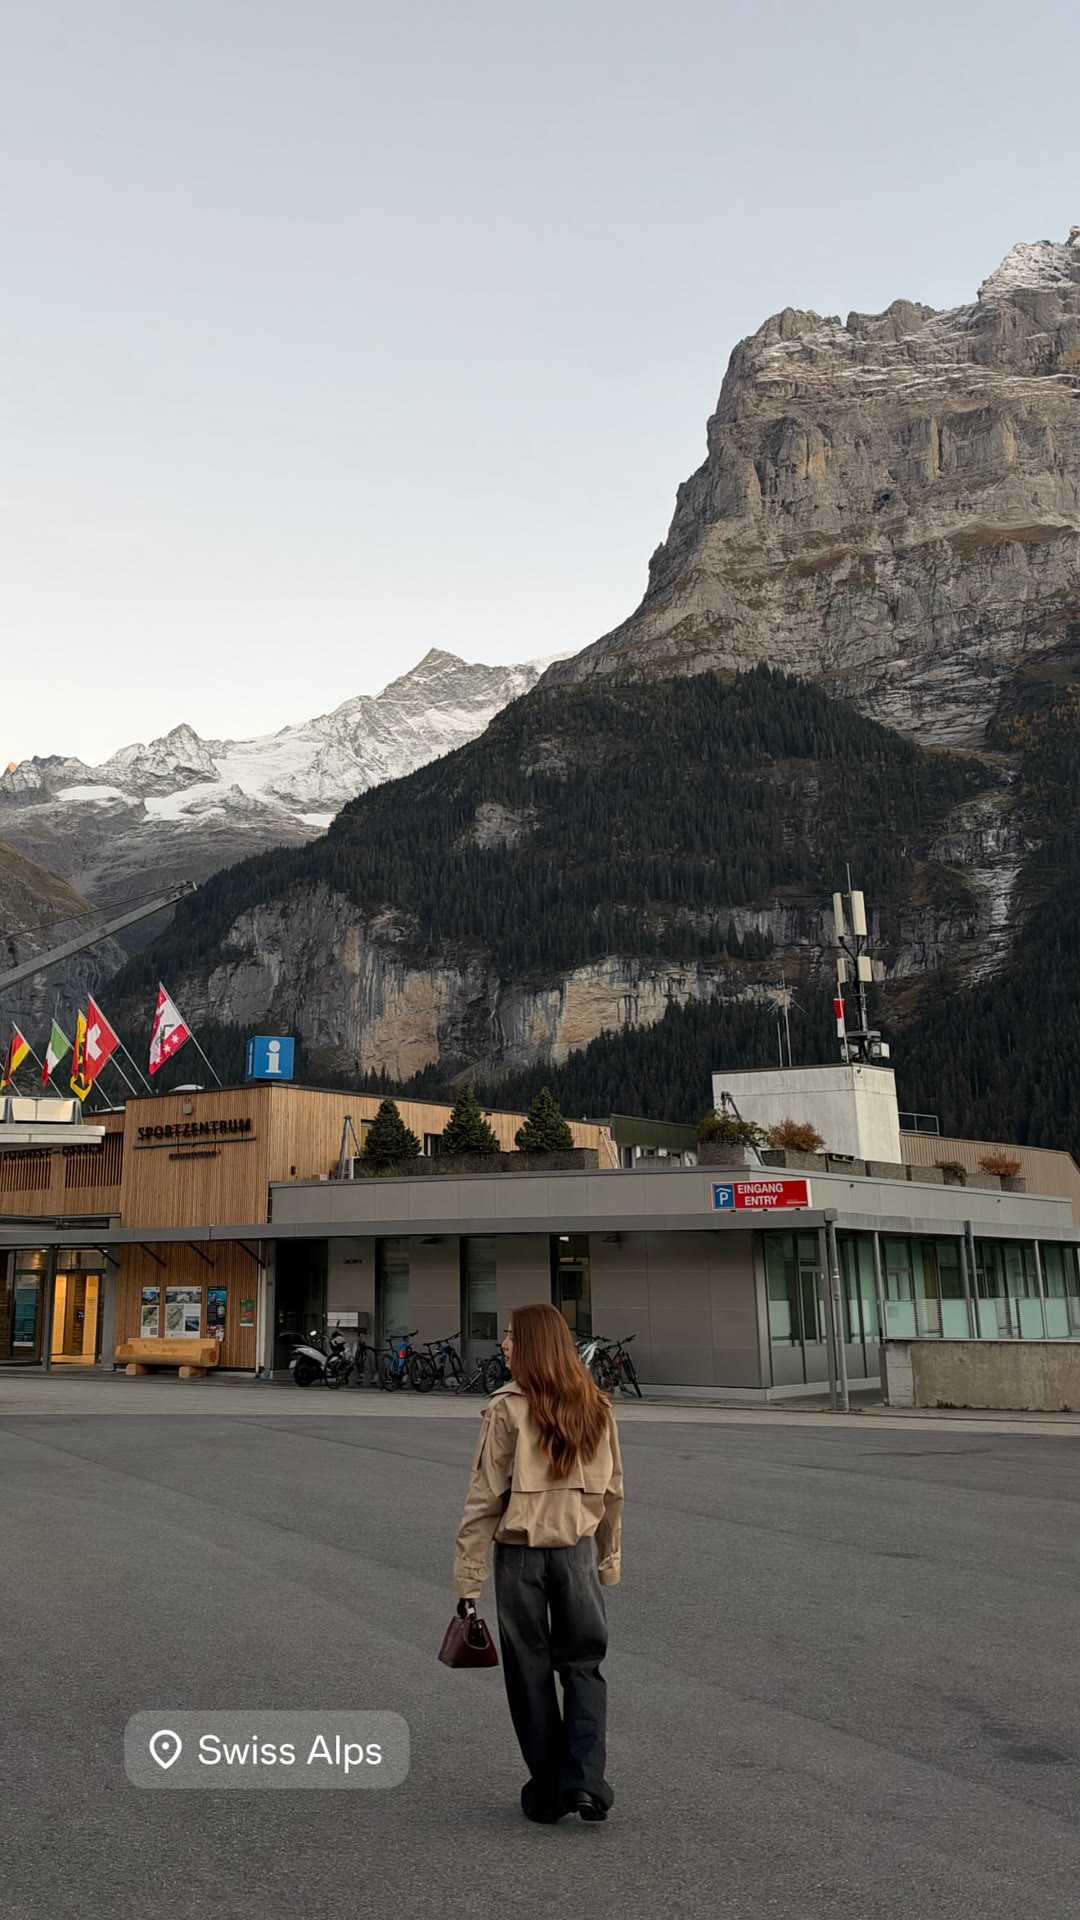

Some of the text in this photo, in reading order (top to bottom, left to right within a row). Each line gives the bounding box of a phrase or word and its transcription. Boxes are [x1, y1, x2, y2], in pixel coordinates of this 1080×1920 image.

[137, 1118, 251, 1140] SPORTZENTRUM
[738, 1183, 784, 1194] EINGANG
[719, 1192, 729, 1205] P
[744, 1195, 778, 1206] ENTRY
